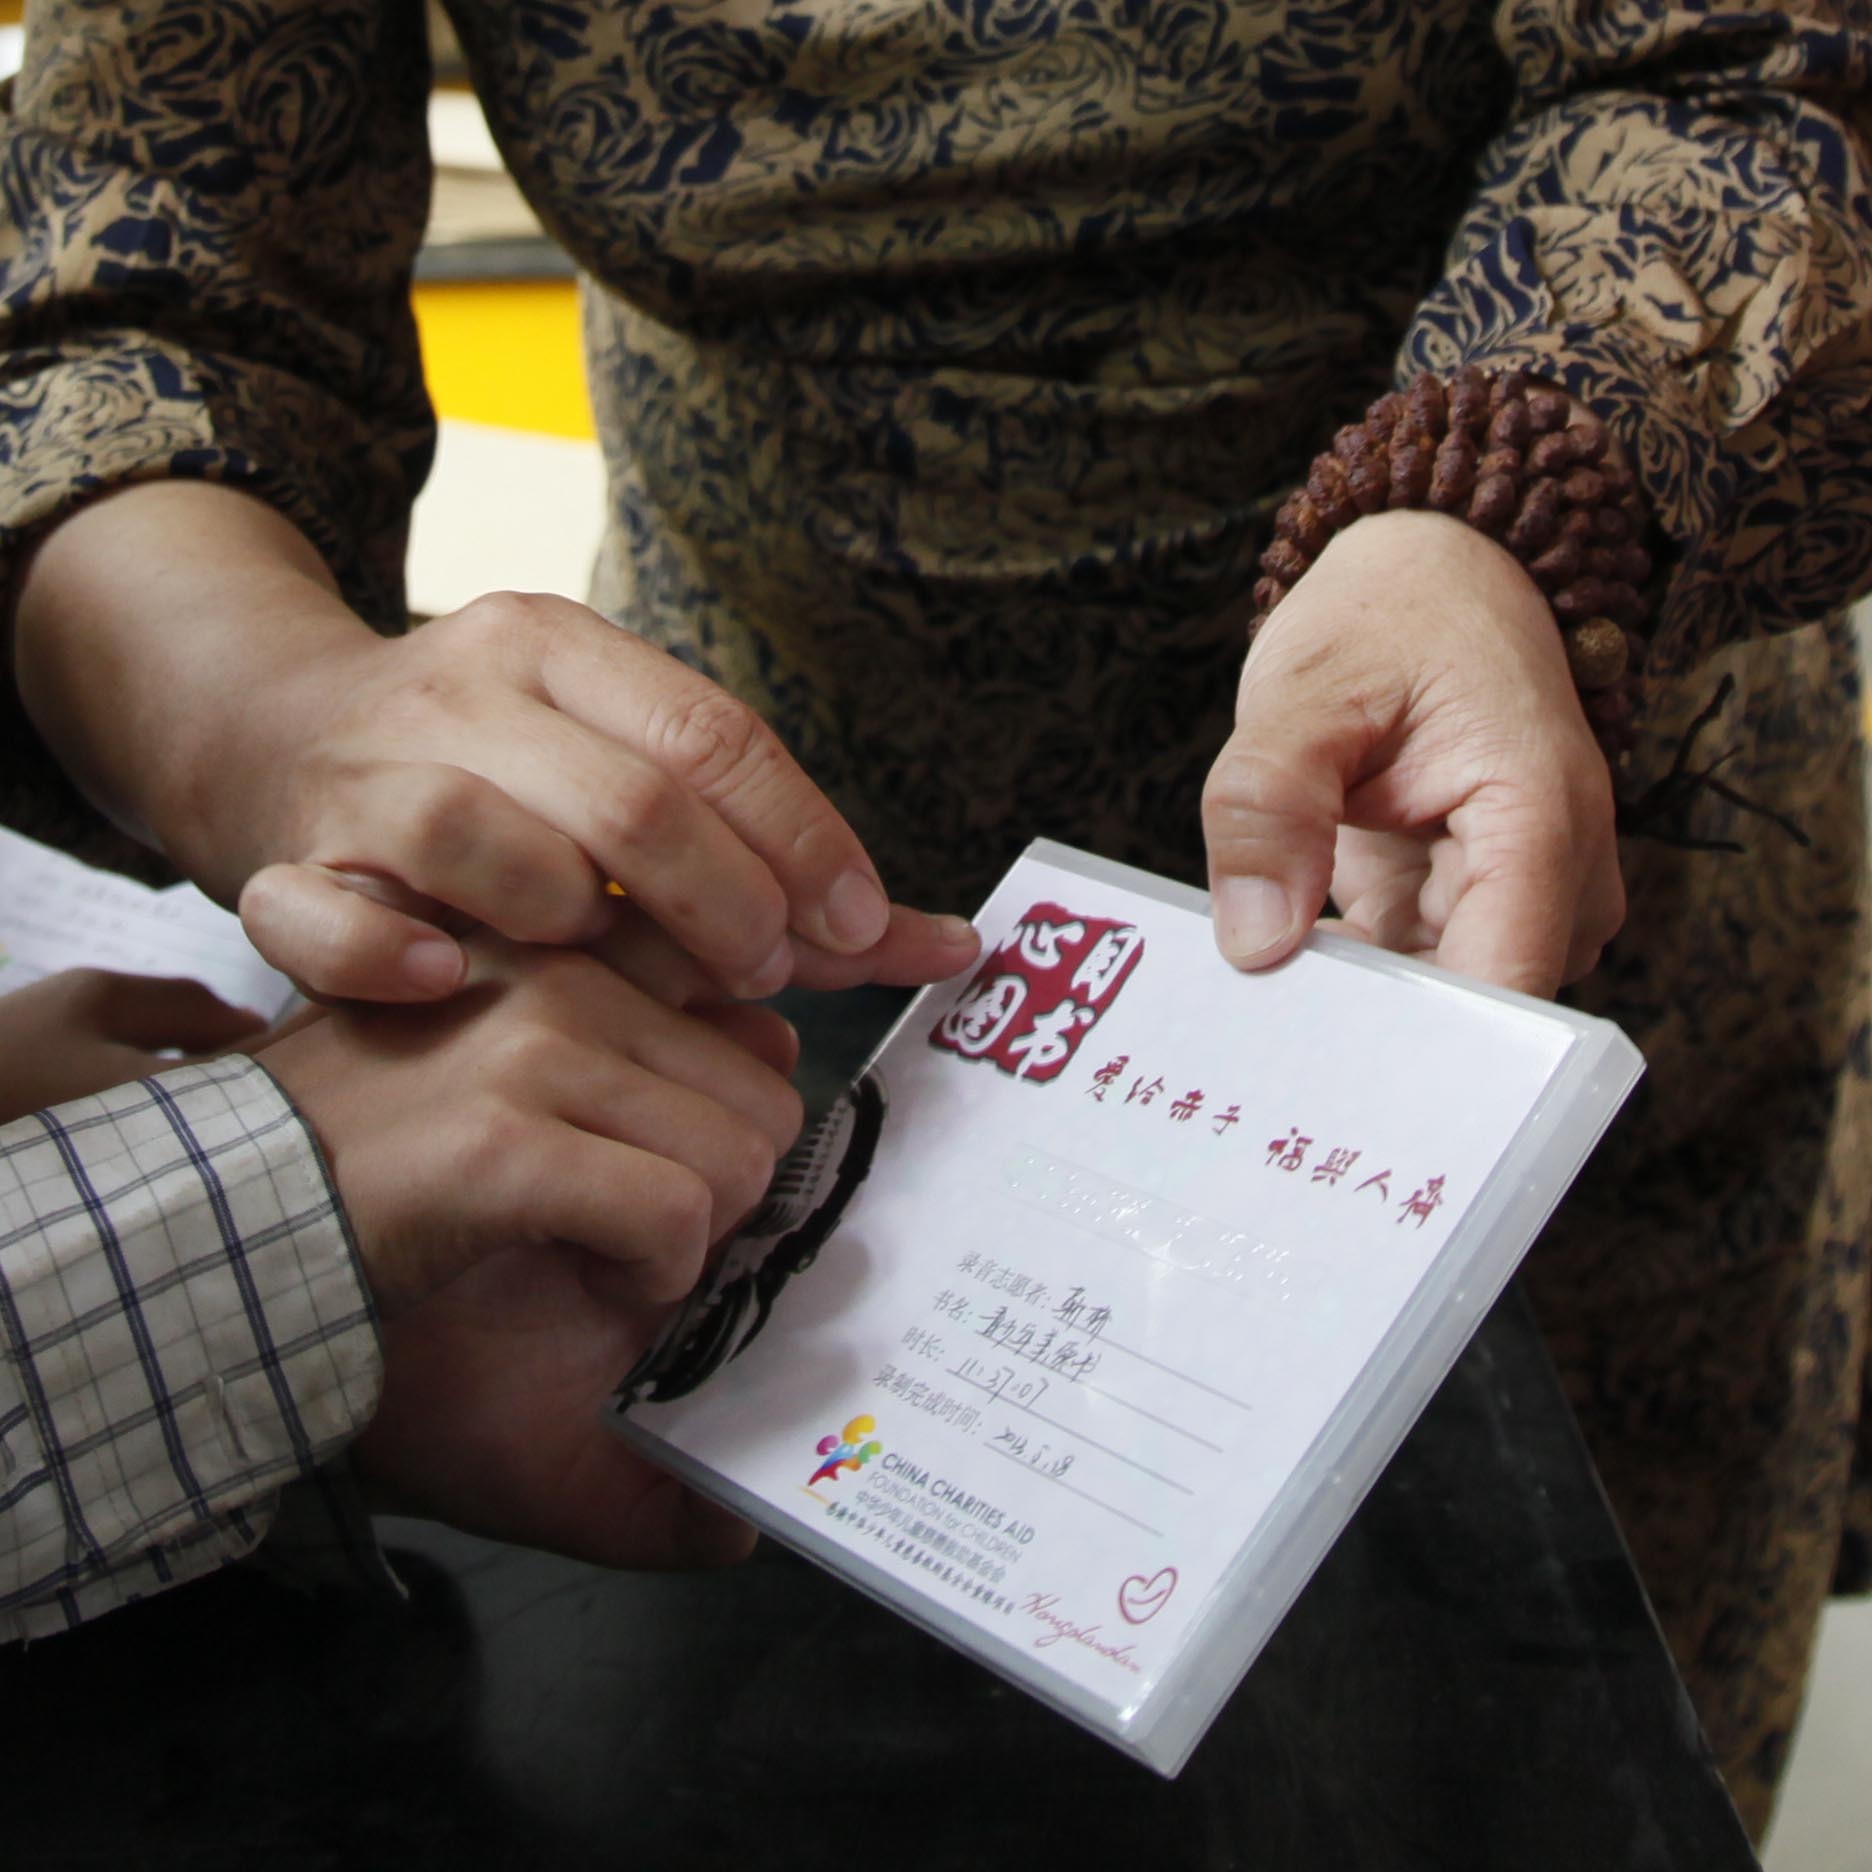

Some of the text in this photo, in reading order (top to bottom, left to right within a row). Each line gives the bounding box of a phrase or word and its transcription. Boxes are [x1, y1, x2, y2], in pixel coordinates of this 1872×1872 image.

[866, 1471, 1024, 1565] FOUNDATION for CHILDREN
[881, 1452, 1037, 1546] CHINA CHARITIES AID
